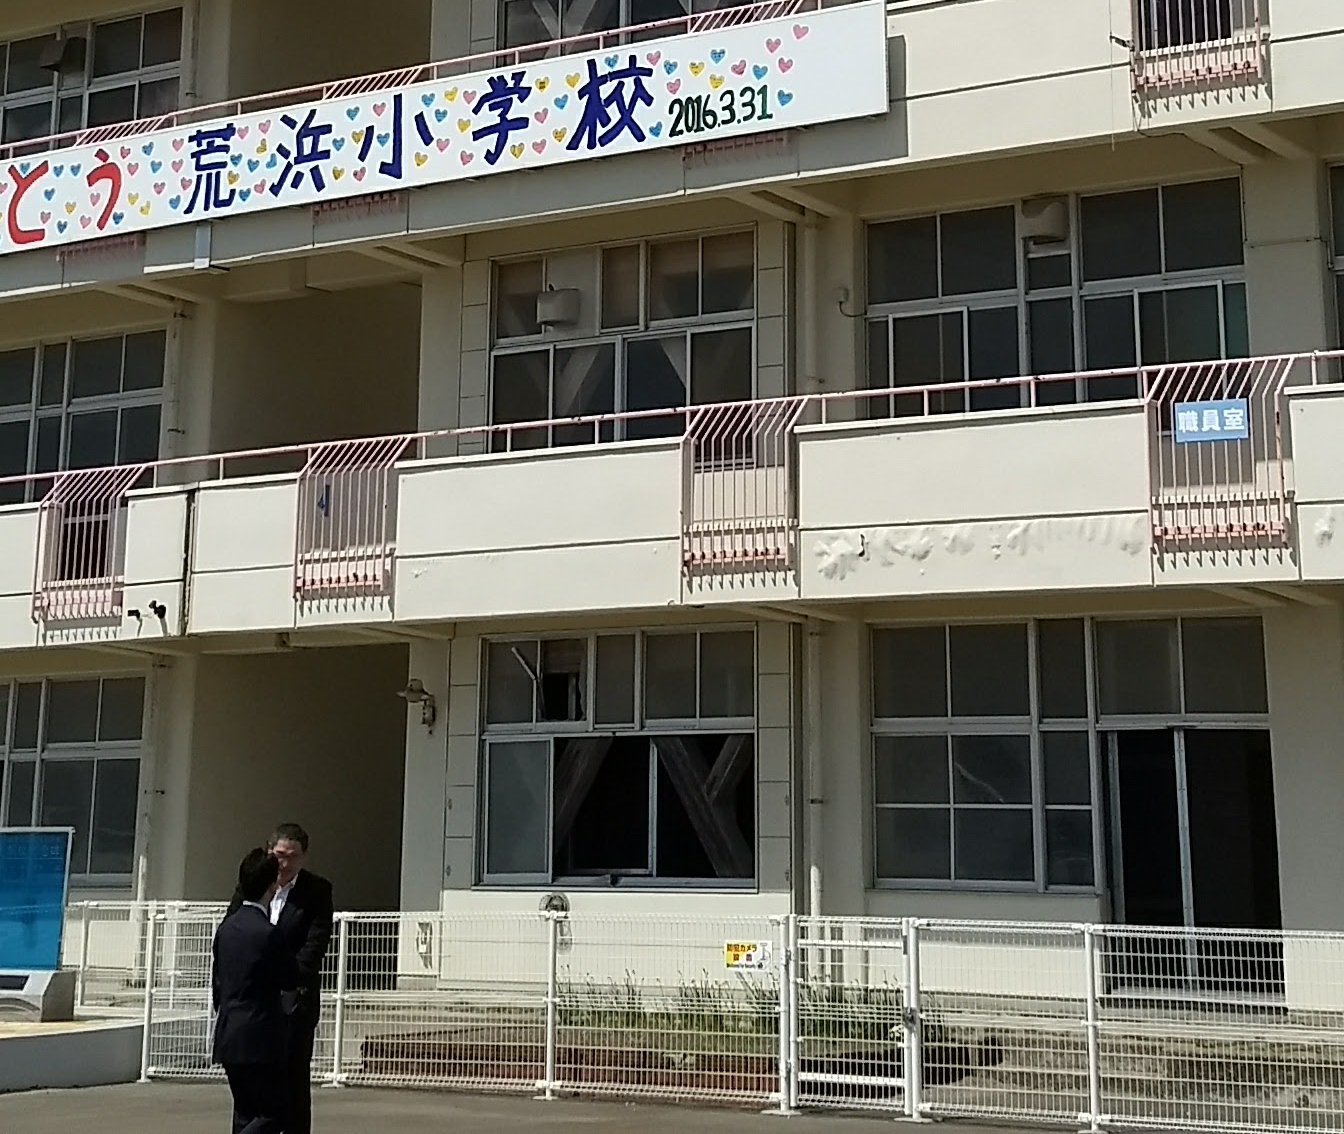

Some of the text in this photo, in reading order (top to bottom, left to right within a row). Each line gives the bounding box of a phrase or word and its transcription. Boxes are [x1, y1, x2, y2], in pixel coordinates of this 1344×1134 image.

[668, 83, 774, 138] 2016.3.31
[1177, 407, 1245, 434] 職員室
